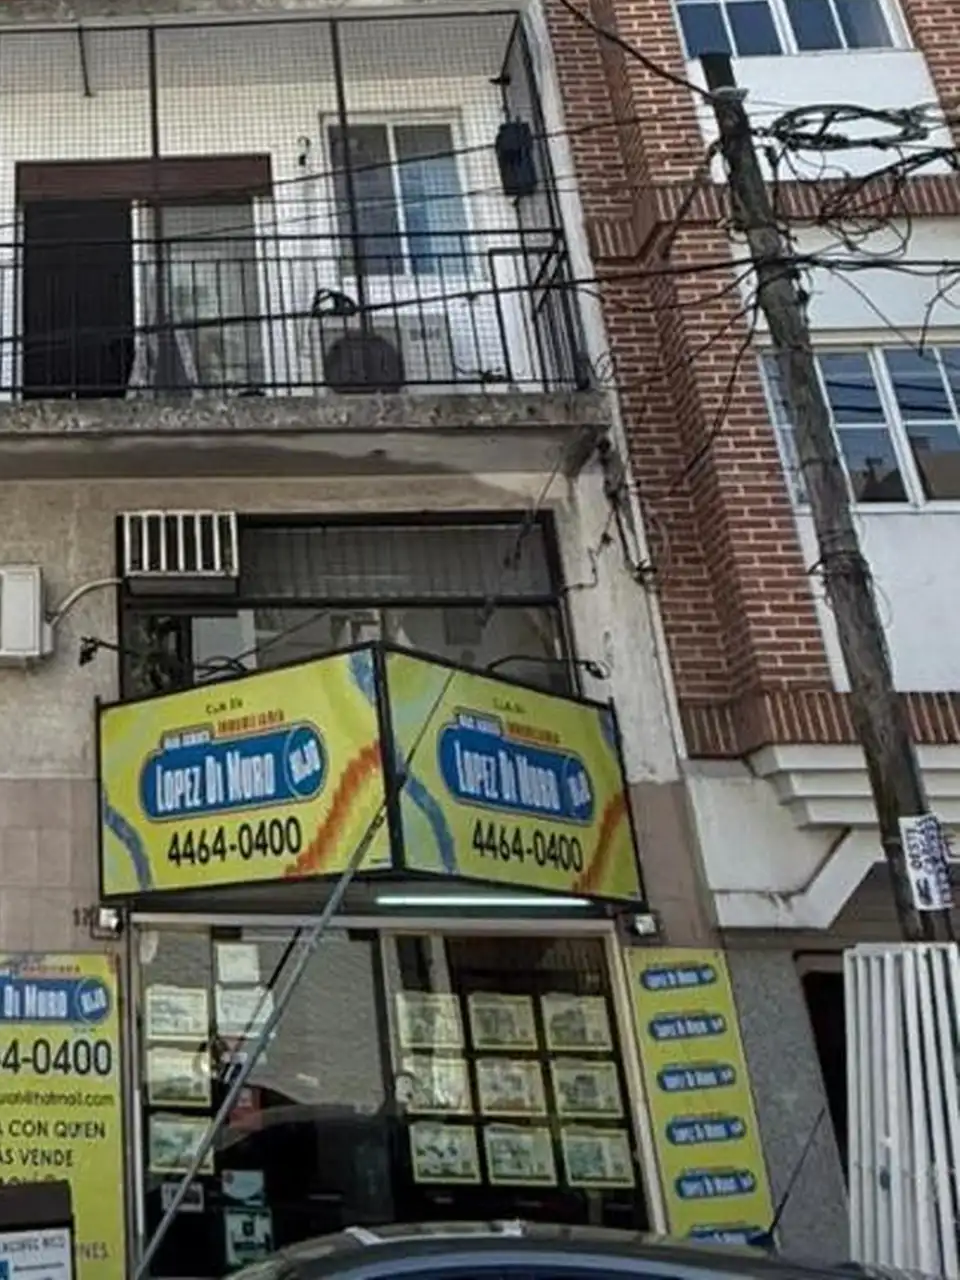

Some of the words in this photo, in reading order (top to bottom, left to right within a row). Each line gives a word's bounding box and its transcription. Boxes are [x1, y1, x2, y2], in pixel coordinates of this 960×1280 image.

[167, 816, 303, 868] 4464-0400
[471, 819, 584, 873] 4464-0400
[8, 1119, 49, 1138] CON
[54, 1120, 106, 1140] QUIEN
[20, 1149, 74, 1168] VENDE
